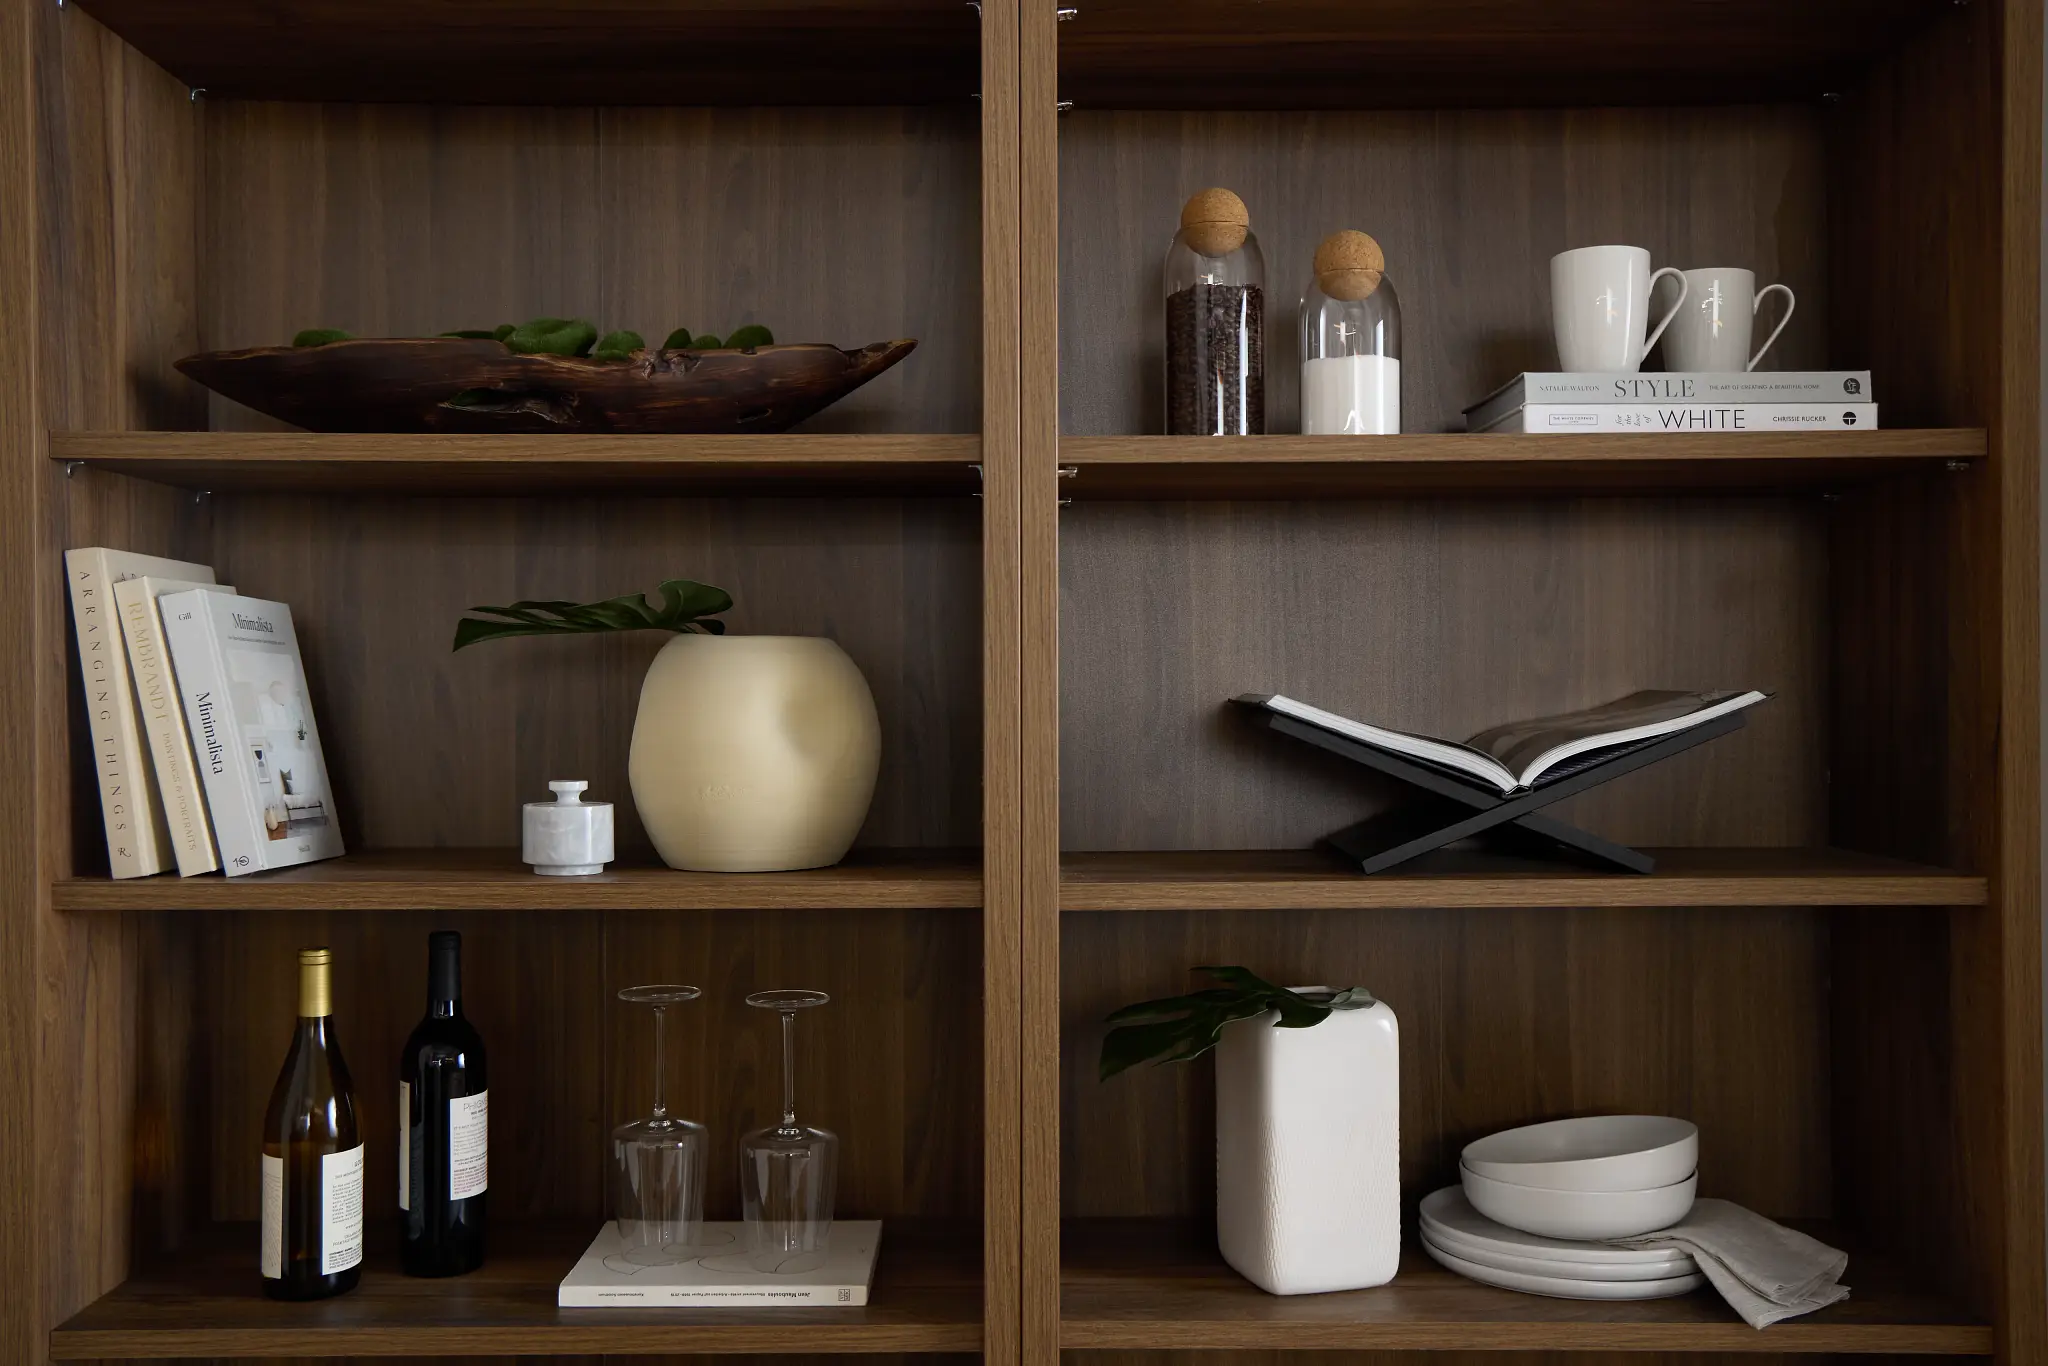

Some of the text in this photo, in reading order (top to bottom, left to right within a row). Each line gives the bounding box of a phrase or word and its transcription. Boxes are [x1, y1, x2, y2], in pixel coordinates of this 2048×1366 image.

[1614, 379, 1695, 398] STYLE
[1615, 414, 1624, 426] for
[1658, 409, 1746, 429] WHITE
[178, 612, 192, 621] Gill
[231, 612, 274, 633] Minimalista
[79, 571, 127, 830] ARRANGING THINGS
[128, 602, 170, 722] REMBRANDT
[163, 733, 181, 783] PAINTINGS
[177, 795, 197, 851] PORTRAITS
[196, 691, 223, 775] Minimalista
